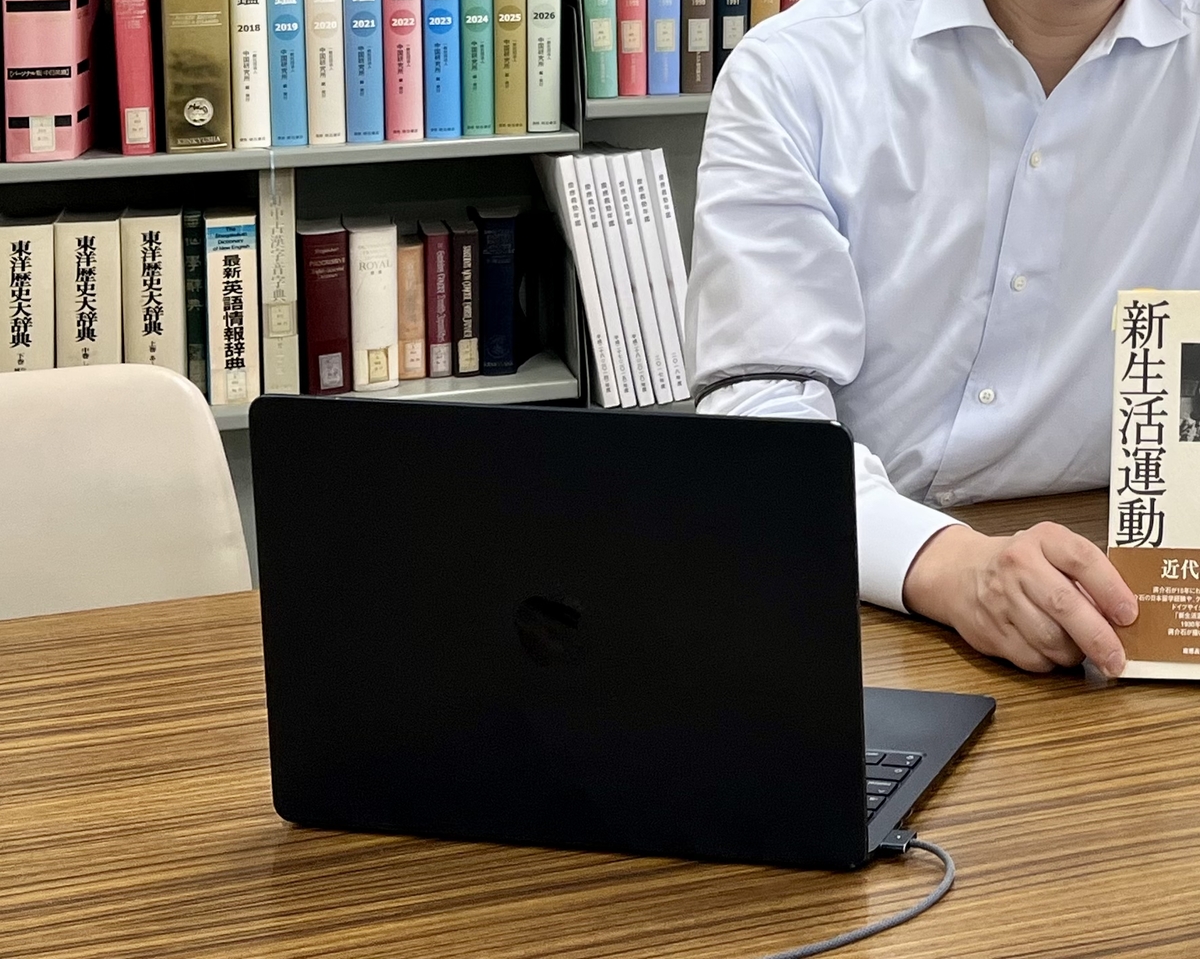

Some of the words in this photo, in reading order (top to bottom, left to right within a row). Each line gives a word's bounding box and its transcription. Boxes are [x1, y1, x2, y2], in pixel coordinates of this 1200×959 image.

[465, 15, 489, 24] 2024
[498, 14, 522, 22] 2025
[533, 12, 556, 20] 2026
[313, 21, 337, 30] 2020
[352, 19, 375, 28] 2021
[391, 17, 415, 27] 2022
[428, 17, 452, 26] 2023
[237, 24, 261, 32] 2018
[274, 22, 299, 31] 2019
[359, 259, 393, 271] ROYAL
[140, 230, 163, 337] 東洋歴史大辞典
[75, 235, 97, 342] 東洋歴史大辞典
[9, 240, 33, 348] 東洋歴史大辞典
[222, 254, 246, 371] 最新英語情報辞典
[1115, 299, 1171, 548] 新生活運動
